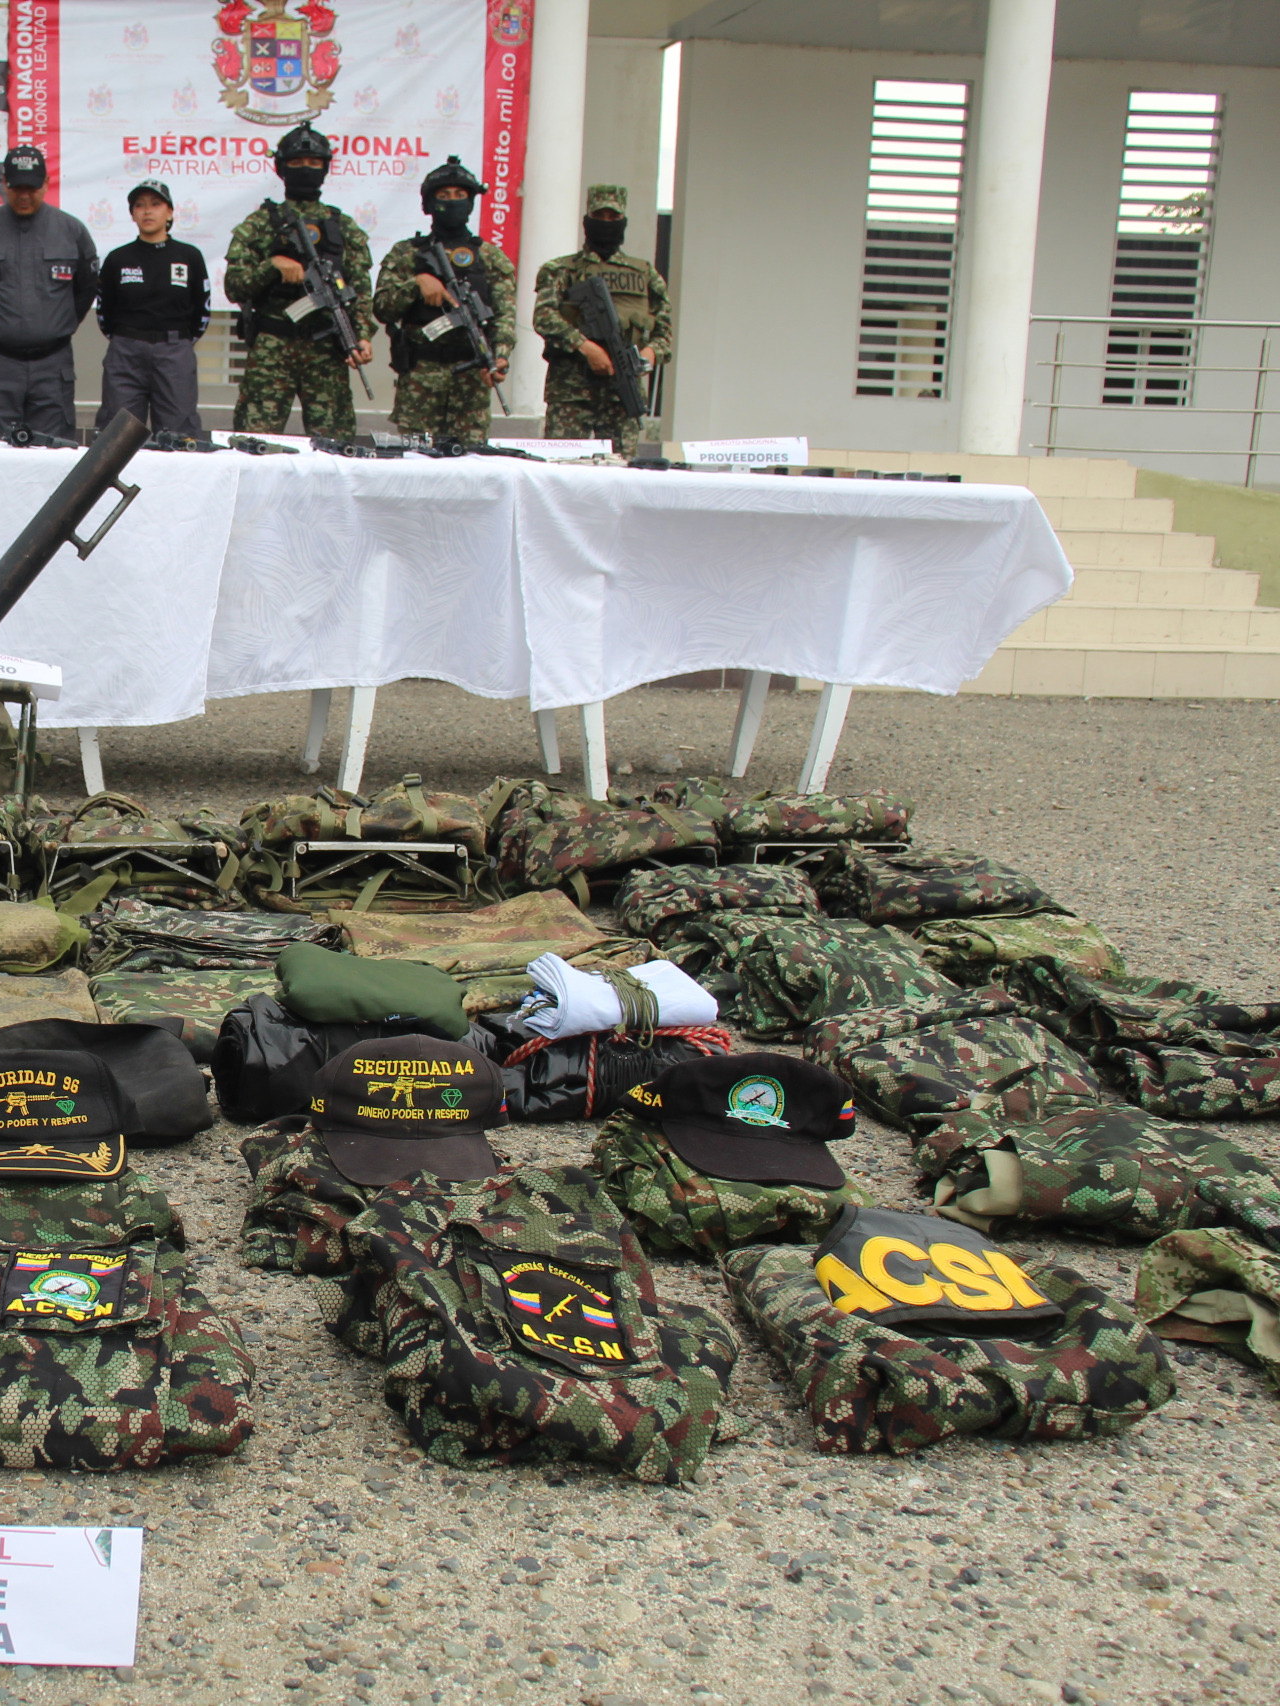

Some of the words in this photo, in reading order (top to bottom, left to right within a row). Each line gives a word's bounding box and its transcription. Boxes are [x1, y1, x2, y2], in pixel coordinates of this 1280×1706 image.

[34, 6, 48, 71] LEALTAD
[17, 0, 33, 99] NACIONA
[35, 79, 48, 134] HONOR
[123, 131, 269, 157] EJÉRCITO
[327, 134, 430, 158] CIONAL
[148, 160, 220, 176] PATRIA
[231, 159, 276, 175] HON
[330, 159, 405, 176] EALTAD
[586, 271, 646, 292] ERCITO
[700, 453, 789, 462] PROVEEDORES
[352, 1058, 452, 1076] SEGURIDAD
[454, 1059, 475, 1075] 44
[62, 1075, 80, 1094] 96
[6, 1118, 39, 1129] PODER
[42, 1118, 48, 1126] Y
[51, 1115, 88, 1127] RESPETO
[357, 1105, 390, 1119] DINERO
[391, 1108, 424, 1119] PODER
[427, 1108, 433, 1119] Y
[435, 1108, 470, 1120] RESPETO
[16, 1252, 62, 1260] FUERZAS
[68, 1253, 127, 1265] ESPECIALES
[548, 1263, 596, 1294] ESPECIALES
[6, 1298, 114, 1322] A.C.S.N
[521, 1323, 625, 1361] A.C.S.N
